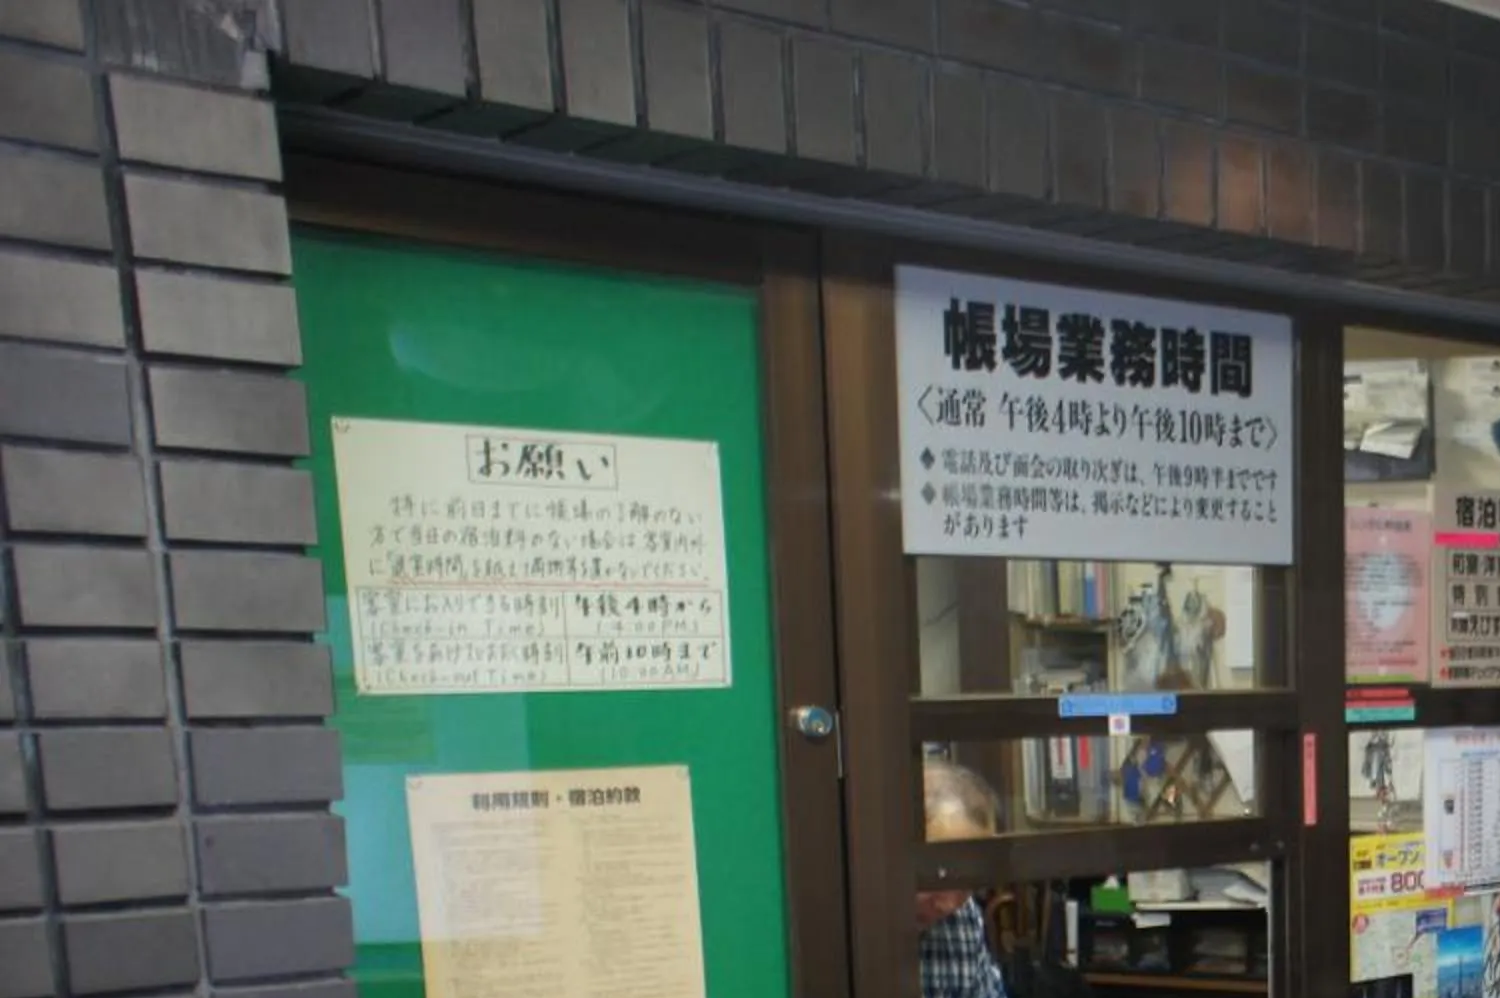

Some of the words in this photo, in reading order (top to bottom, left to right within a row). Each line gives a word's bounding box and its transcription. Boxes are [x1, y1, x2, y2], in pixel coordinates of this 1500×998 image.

[943, 297, 1254, 398] 帳場業務時間
[475, 437, 609, 481] お願い
[943, 510, 1029, 540] があります
